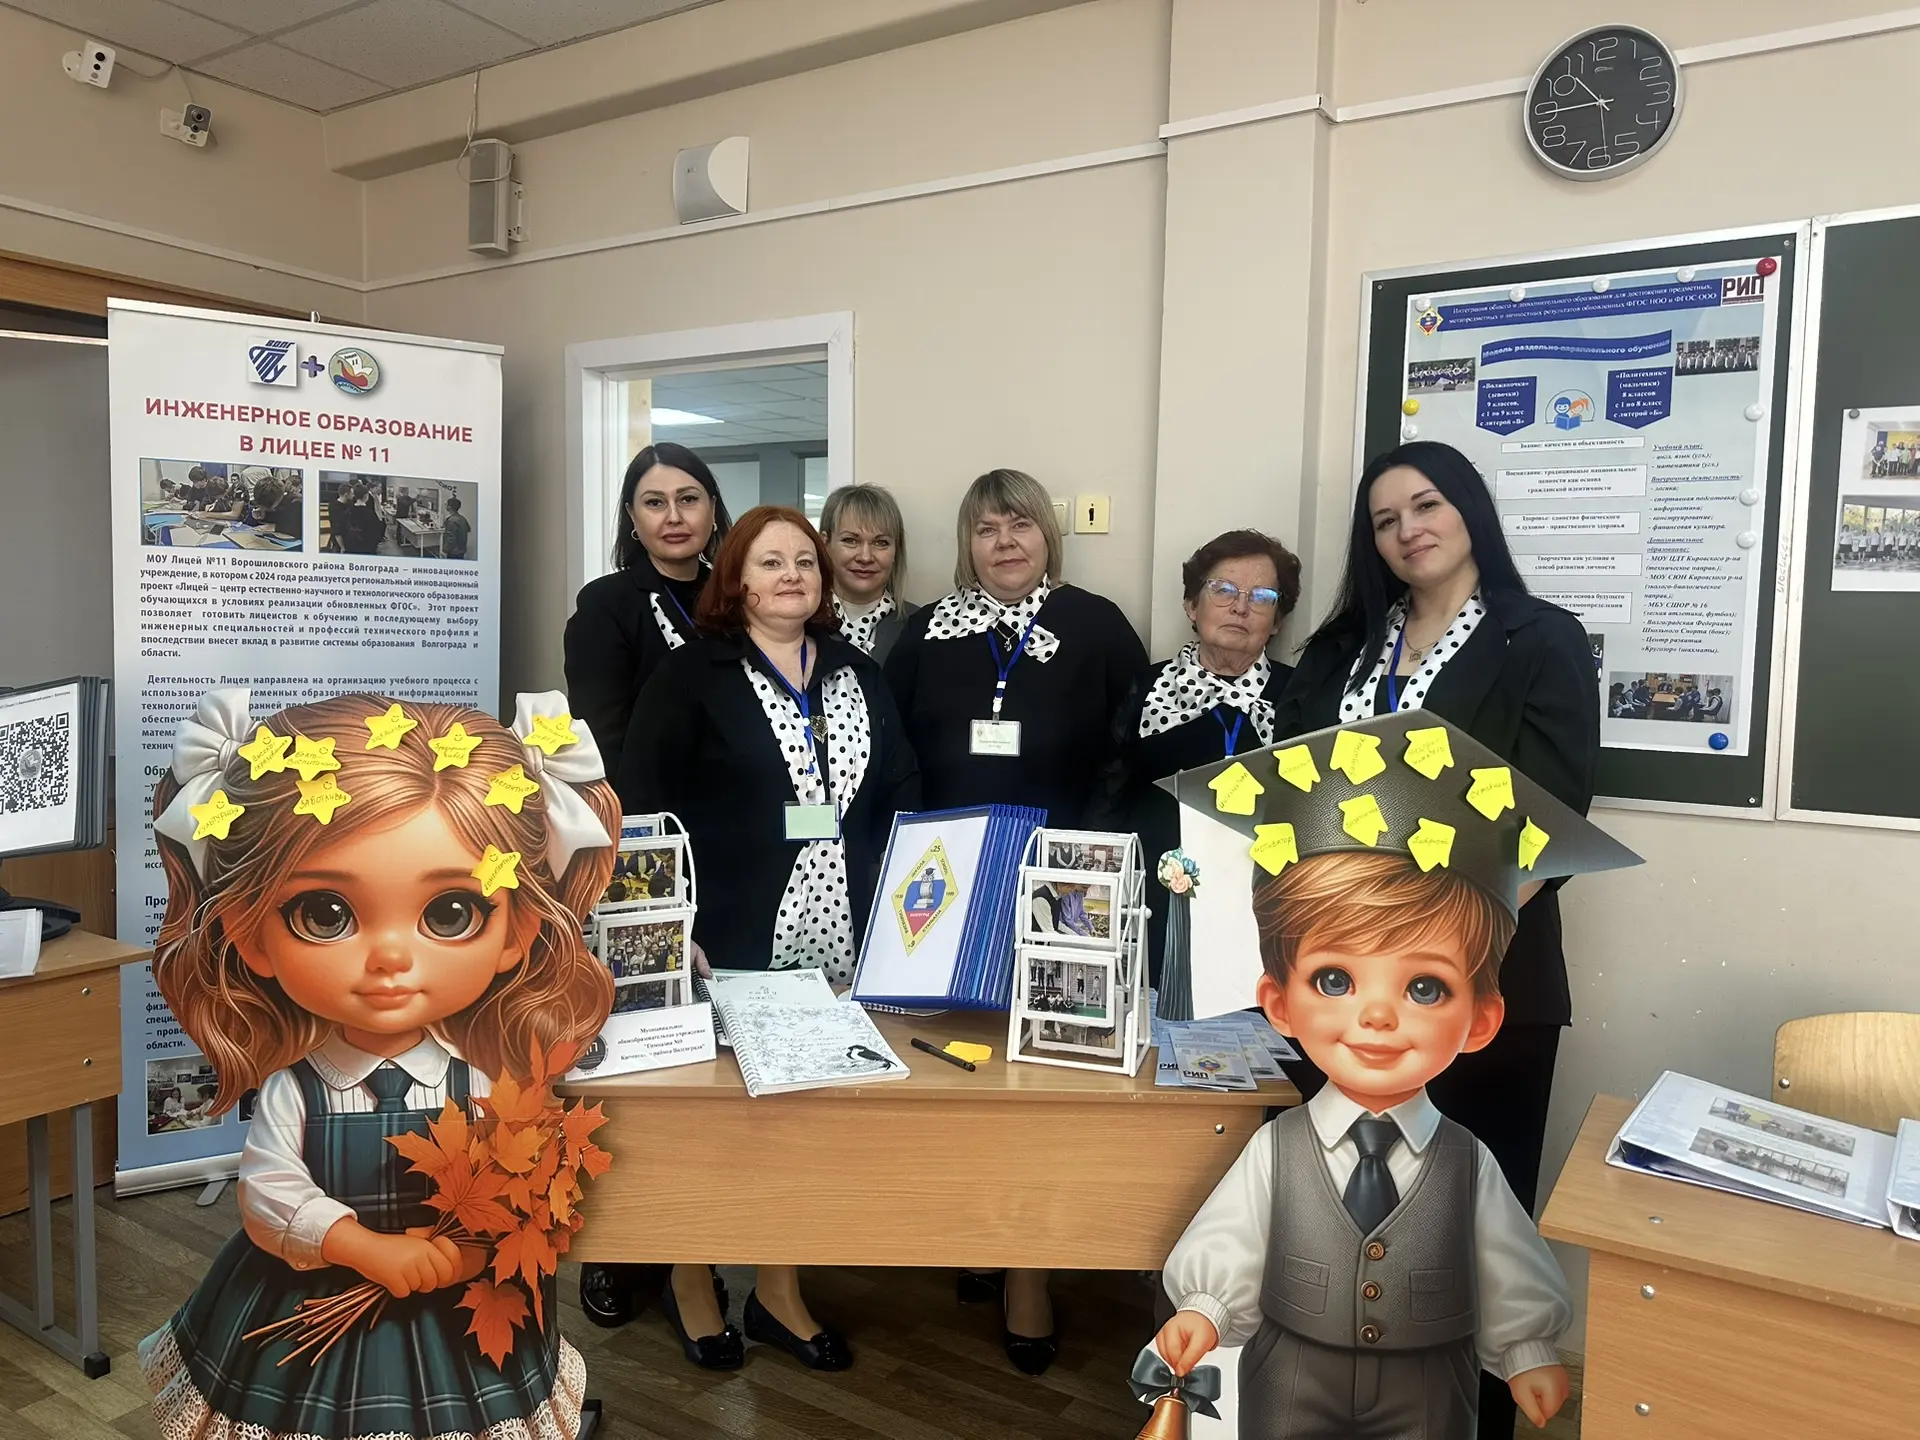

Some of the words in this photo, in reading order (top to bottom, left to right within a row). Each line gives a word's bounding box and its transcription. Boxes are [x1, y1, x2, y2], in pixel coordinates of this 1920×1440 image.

[1589, 37, 1618, 61] 12
[1630, 38, 1637, 59] 1
[1564, 54, 1584, 74] 11
[1640, 56, 1662, 80] 2
[1546, 74, 1576, 97] 10
[1646, 82, 1670, 106] 3
[1535, 101, 1558, 123] 9
[1636, 110, 1660, 130] 4
[1543, 125, 1565, 148] 8
[1614, 132, 1639, 156] 5
[1567, 141, 1586, 165] 7
[1587, 146, 1611, 168] 6
[1723, 276, 1764, 297] РИП
[1626, 299, 1647, 307] ФГОС
[266, 340, 295, 348] ВОЛГ
[145, 398, 311, 428] ИНЖЕНЕРНОЕ
[317, 413, 473, 443] ОБРАЗОВАНИЕ
[239, 436, 253, 451] В
[259, 438, 335, 459] ЛИЦЕЕ
[341, 444, 362, 461] №
[369, 447, 390, 463] 11
[147, 554, 167, 563] МОУ
[172, 555, 202, 565] Лицей
[206, 556, 226, 565] №11
[232, 557, 309, 569] Ворошиловского
[313, 563, 344, 572] района
[349, 563, 399, 574] Волгограда
[412, 567, 478, 576] инновационное
[140, 569, 201, 579] учреждение,
[210, 572, 247, 580] котором
[255, 572, 275, 580] 2024
[277, 574, 296, 582] года
[298, 574, 350, 584] реализуется
[352, 577, 412, 586] региональный
[414, 580, 478, 589] инновационный
[140, 582, 173, 592] проект
[176, 583, 208, 592] «Лицей
[220, 586, 246, 594] центр
[249, 587, 343, 597] естественно-научного
[353, 591, 424, 599] технологического
[427, 592, 478, 601] образования
[140, 595, 207, 606] обучающихся
[222, 599, 264, 608] условиях
[268, 600, 323, 608] реализации
[327, 600, 386, 610] обновленных
[390, 602, 420, 611] ФГОС».
[428, 604, 446, 612] Этот
[450, 605, 478, 614] проект
[203, 611, 245, 619] готовить
[313, 612, 358, 623] обучению
[374, 616, 440, 626] последующему
[447, 616, 478, 626] выбору
[141, 623, 208, 632] инженерных
[213, 623, 294, 633] специальностей
[309, 625, 359, 636] профессий
[364, 627, 426, 636] технического
[430, 628, 469, 638] профиля
[141, 636, 205, 645] впоследствии
[208, 637, 238, 645] внесет
[242, 638, 268, 646] вклад
[280, 638, 320, 647] развитие
[323, 639, 358, 647] системы
[362, 639, 415, 649] образования
[422, 640, 467, 649] Волгограда
[141, 648, 181, 657] области.
[148, 675, 216, 684] Деятельность
[220, 676, 249, 684] Лицея
[254, 677, 308, 685] направлена
[328, 676, 386, 686] организацию
[389, 676, 430, 686] учебного
[433, 678, 470, 686] процесса
[389, 689, 395, 697] и
[399, 688, 478, 699] информационных
[142, 702, 197, 710] технологий
[250, 702, 281, 711] ранней
[146, 1040, 186, 1050] области.
[1183, 1070, 1209, 1079] РИП
